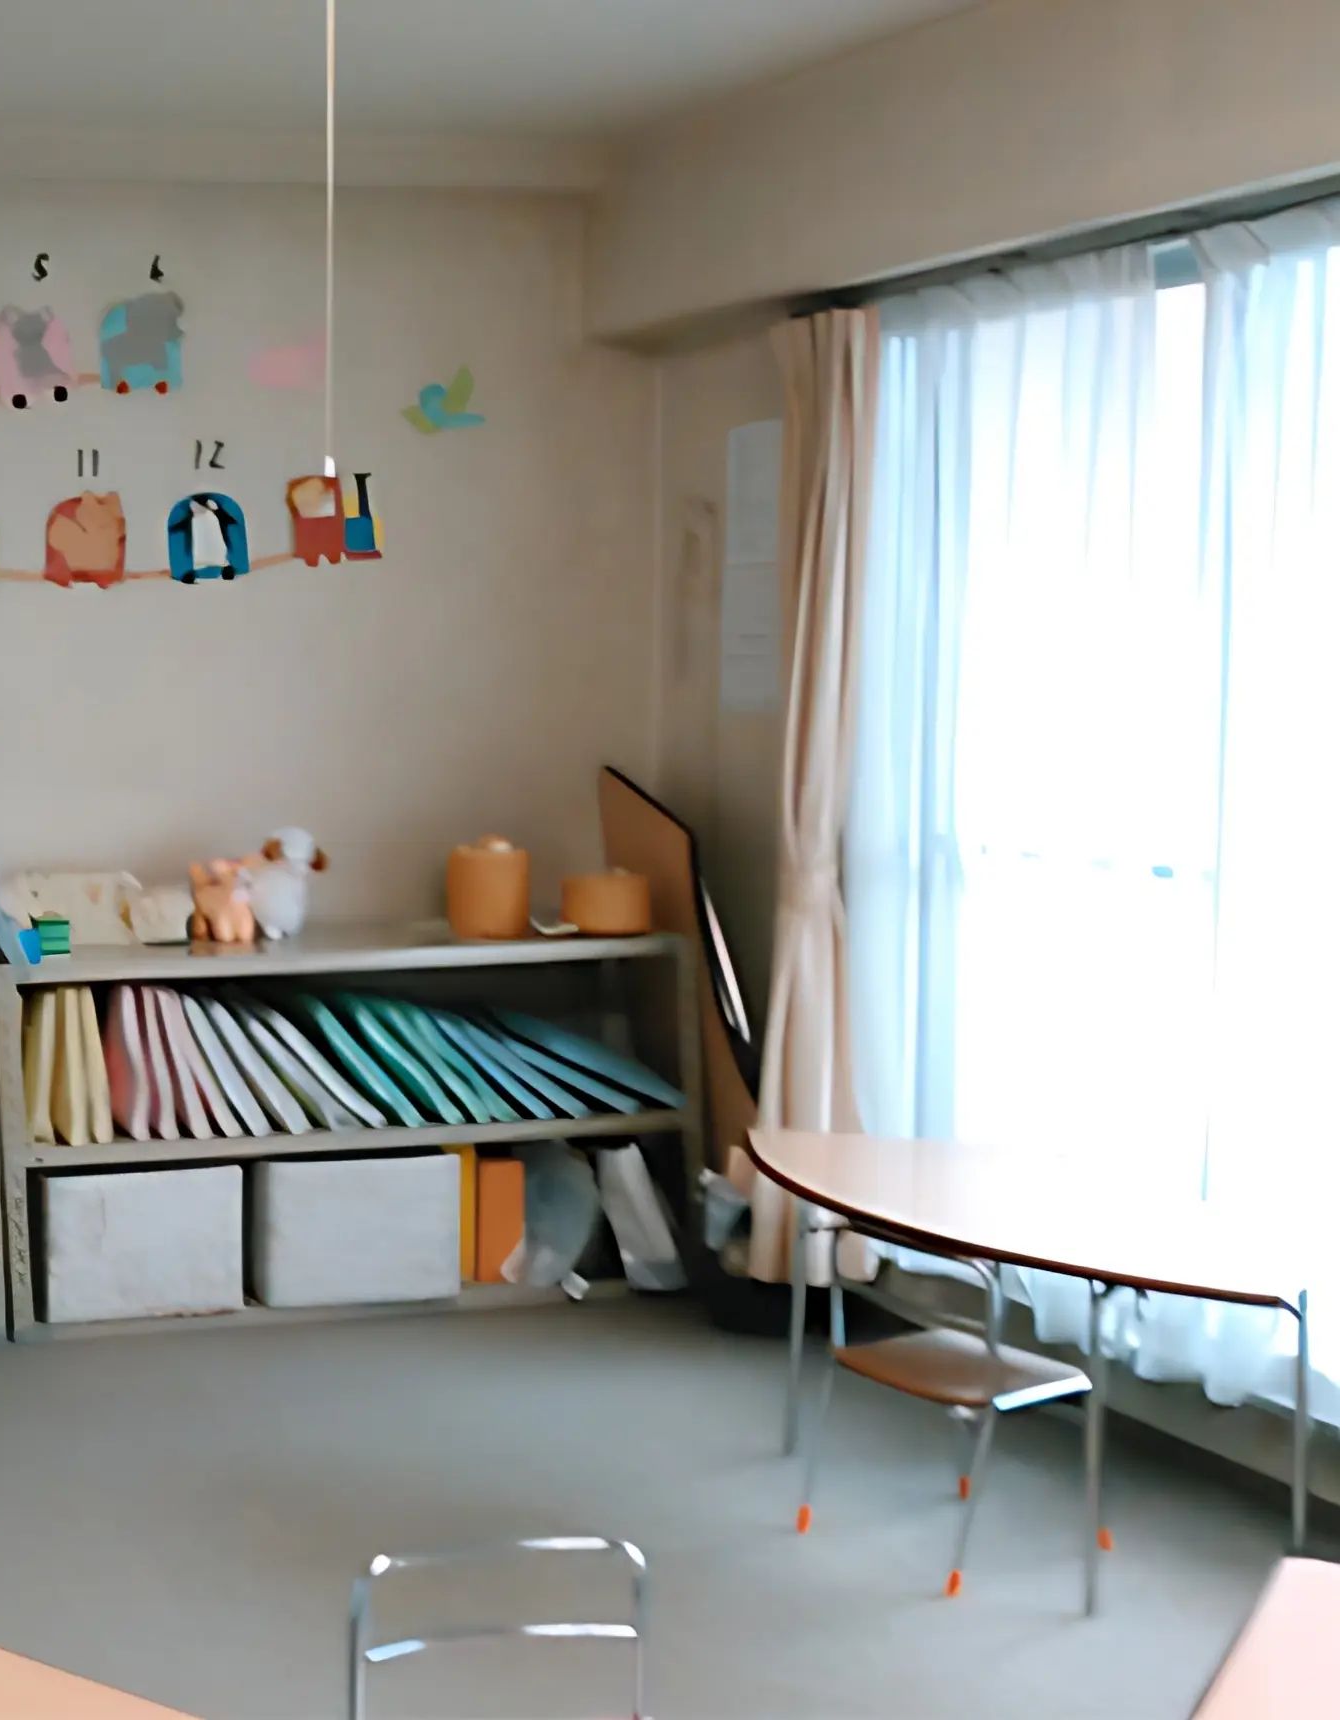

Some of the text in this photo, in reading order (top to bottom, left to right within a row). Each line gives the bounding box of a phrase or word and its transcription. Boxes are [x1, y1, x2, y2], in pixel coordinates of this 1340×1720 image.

[31, 252, 50, 283] 5
[76, 448, 100, 478] 11
[194, 439, 226, 470] 12
